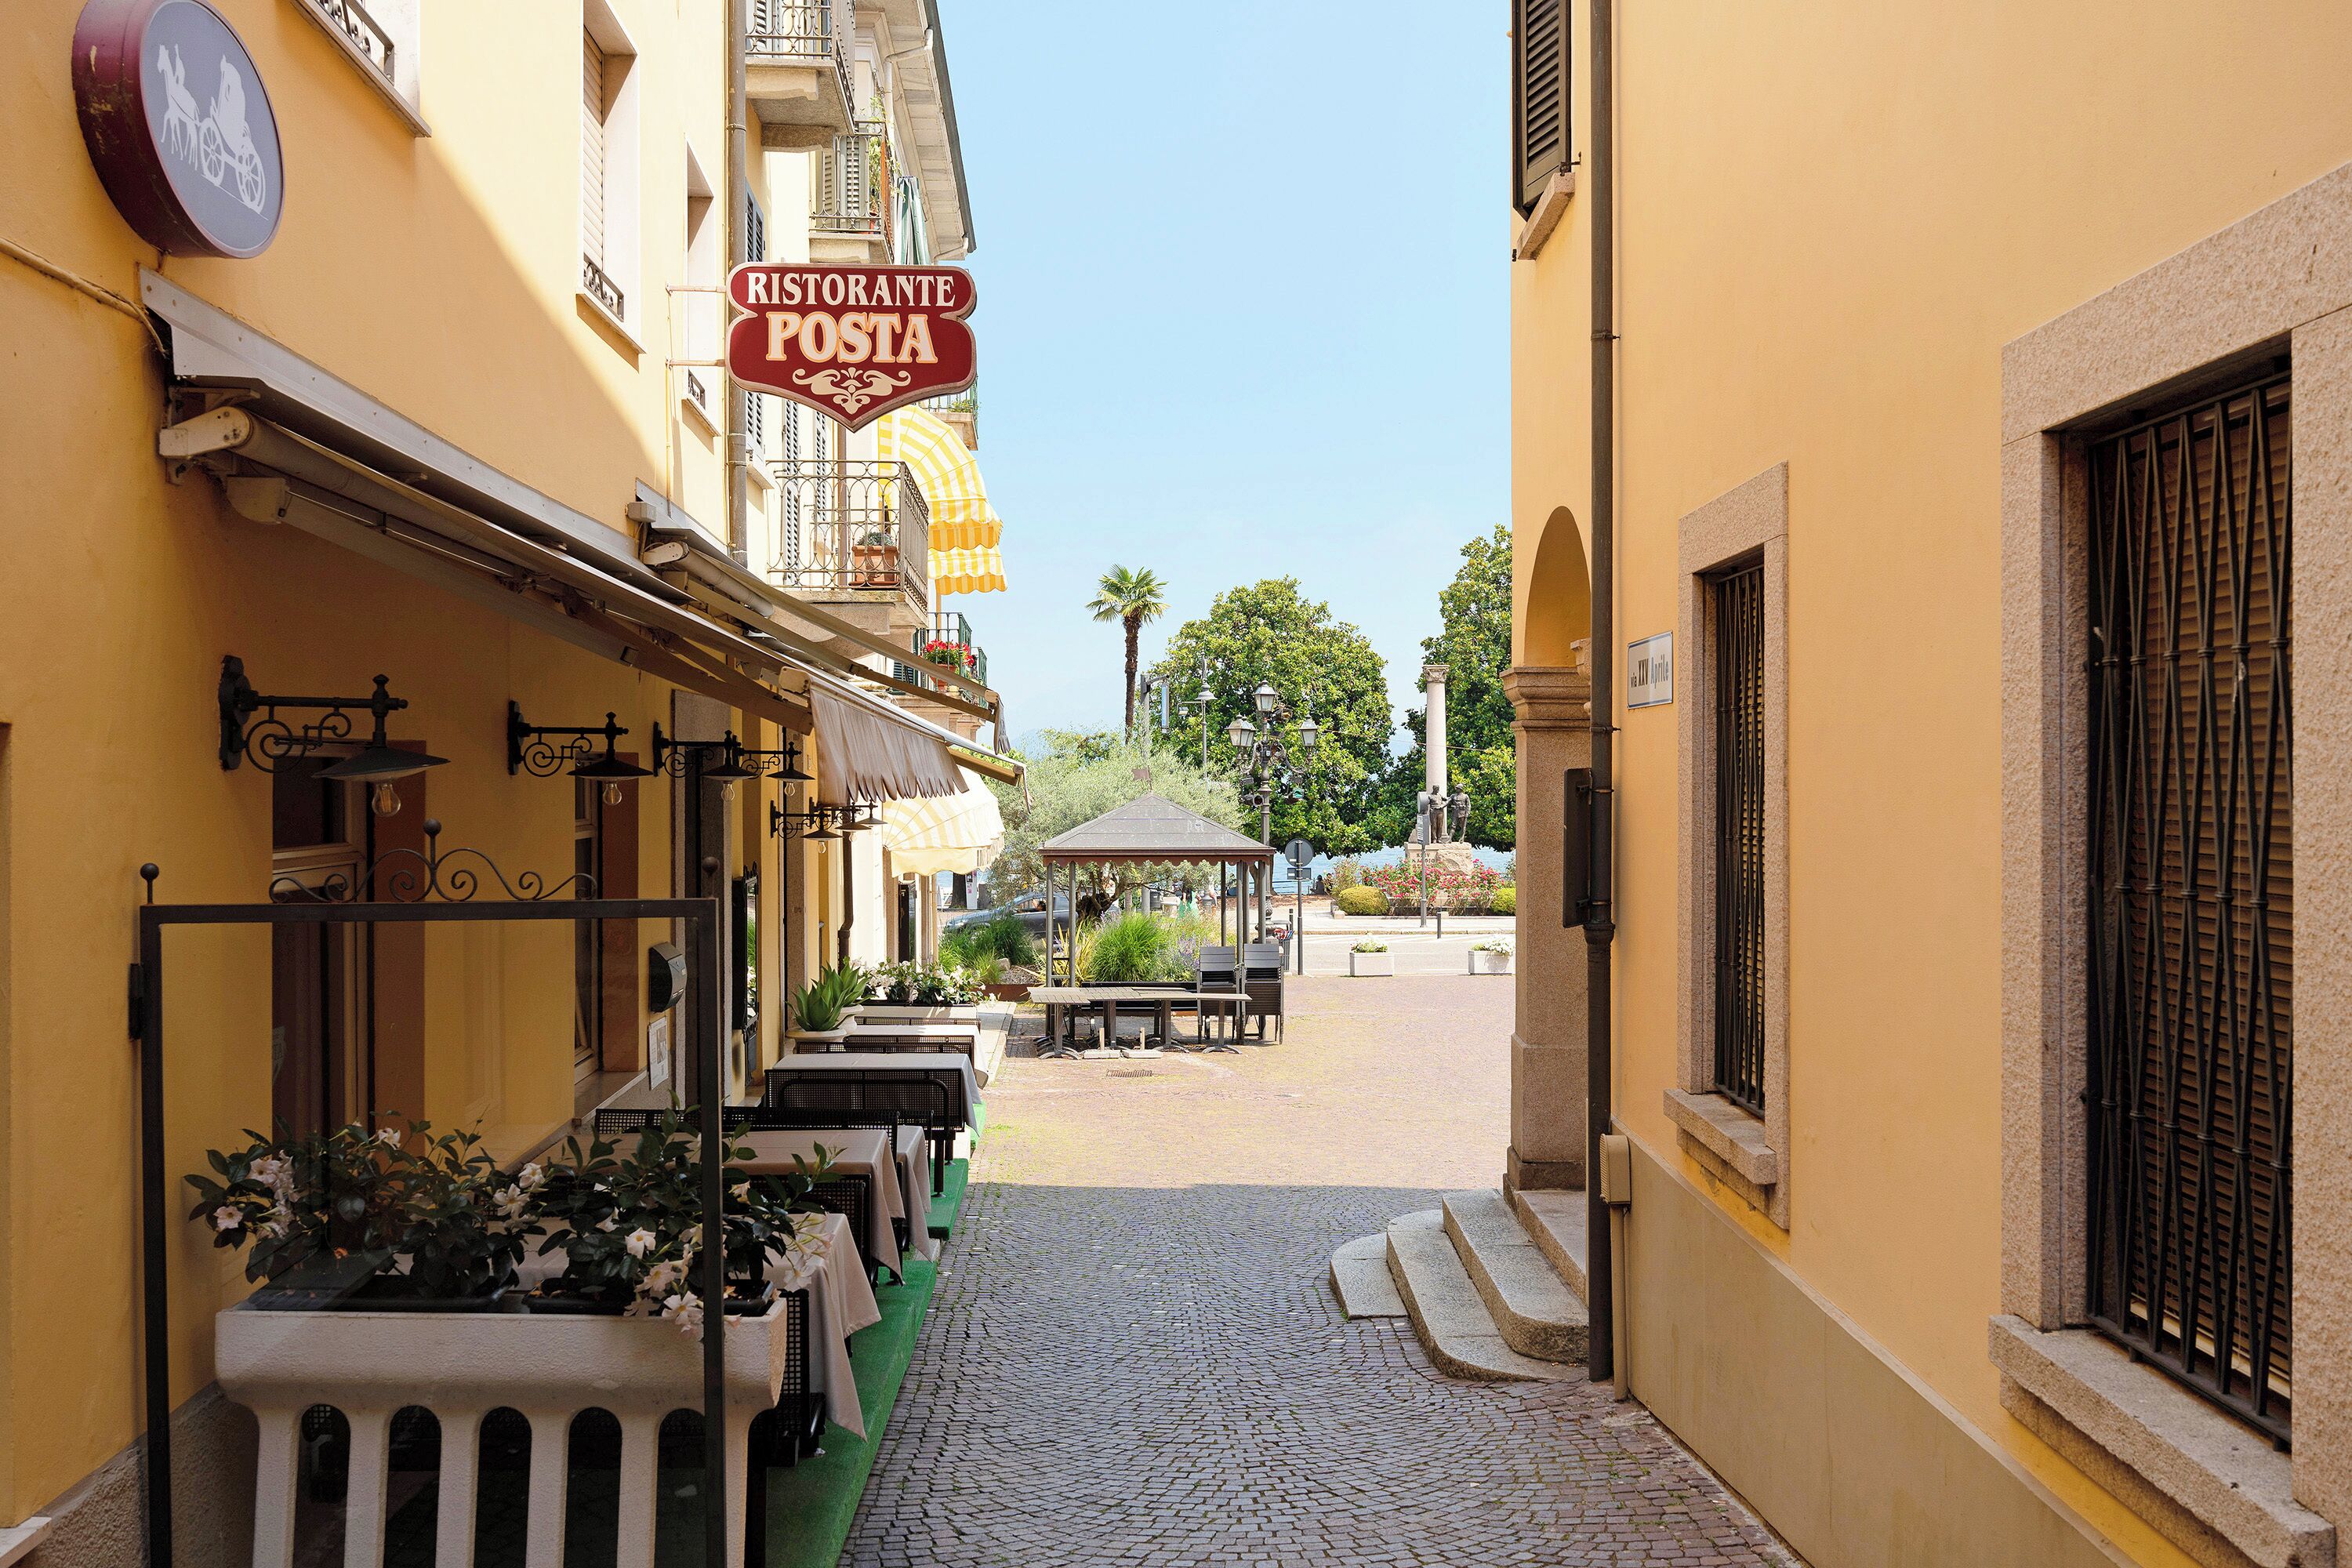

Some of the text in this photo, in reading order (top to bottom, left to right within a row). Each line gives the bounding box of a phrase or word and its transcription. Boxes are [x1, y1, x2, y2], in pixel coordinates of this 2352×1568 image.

[746, 272, 956, 307] RISTORANTE
[765, 311, 938, 364] POSTA
[1639, 659, 1649, 686] XXV
[1650, 654, 1669, 689] Aprile
